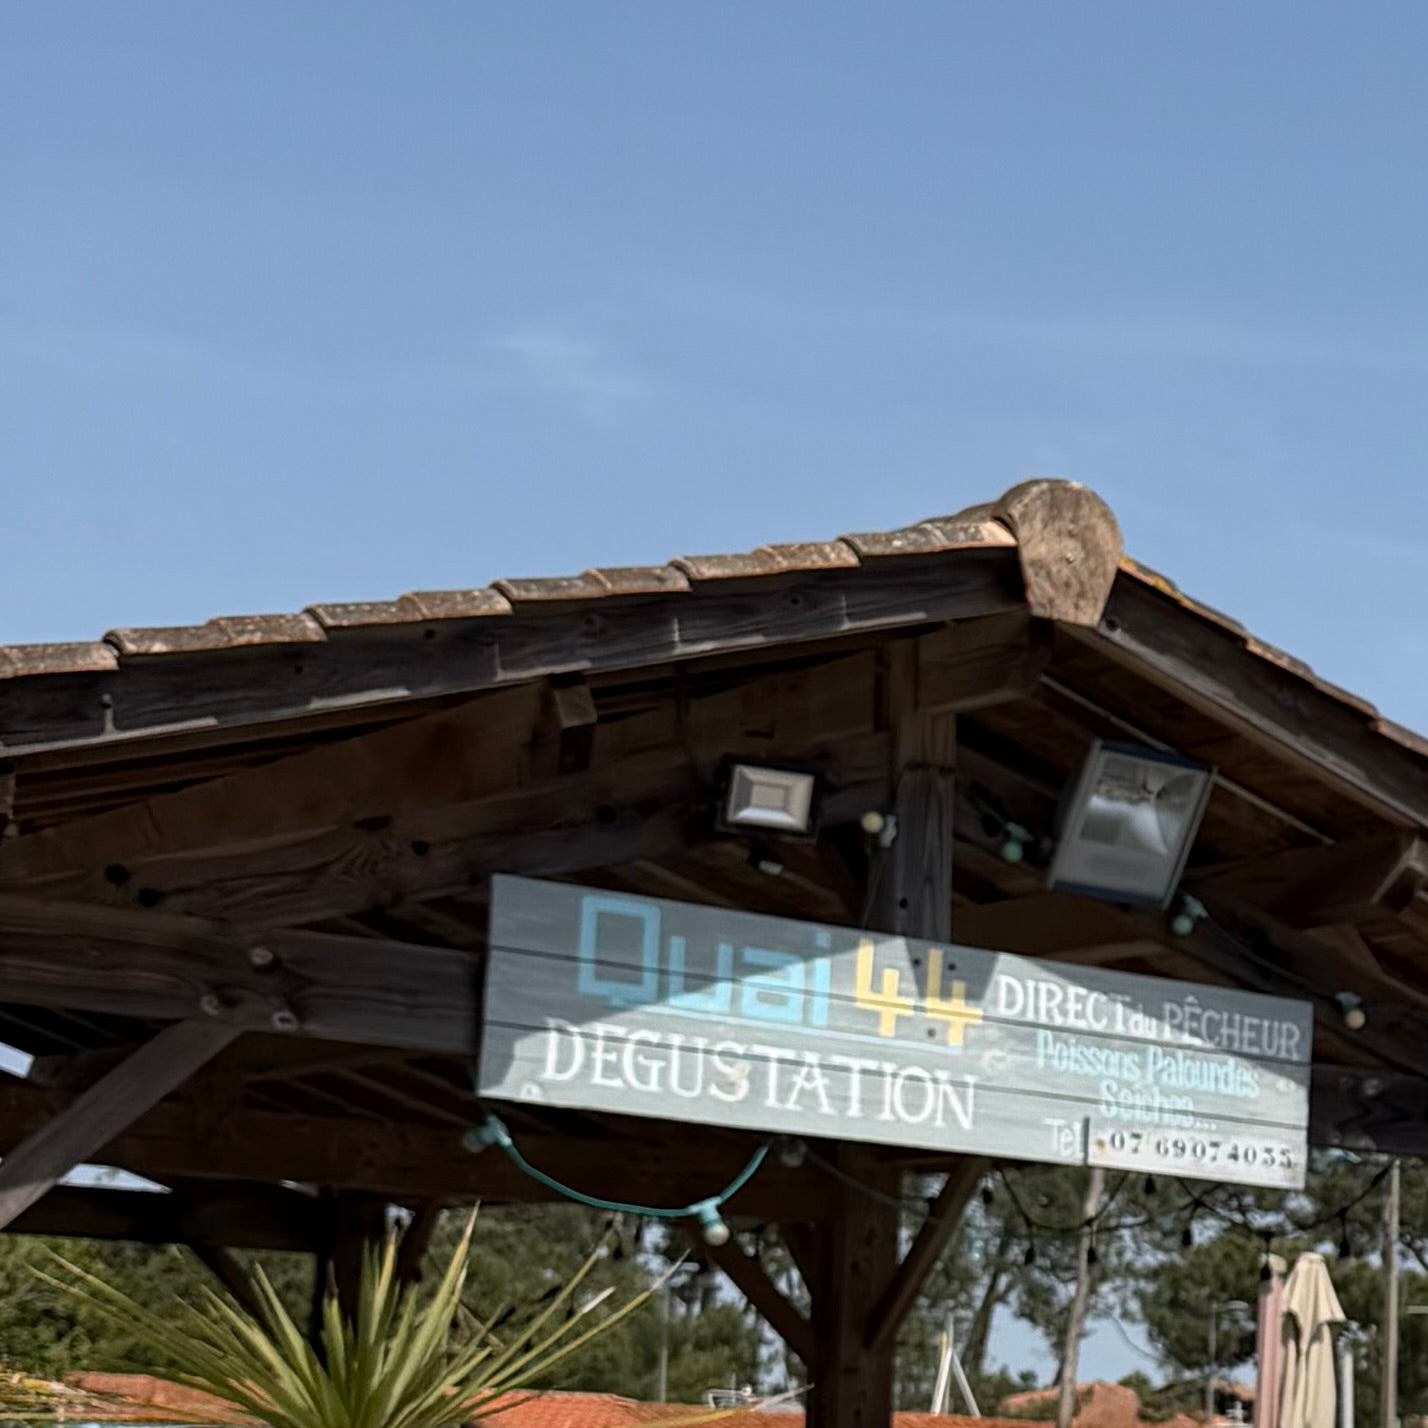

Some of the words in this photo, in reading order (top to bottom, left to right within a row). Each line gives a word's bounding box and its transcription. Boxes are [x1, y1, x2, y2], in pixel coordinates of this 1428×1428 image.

[579, 896, 831, 1027] Quai
[856, 938, 983, 1047] 44
[997, 974, 1132, 1032] DIRECT
[1162, 995, 1302, 1061] PÊCHEUR
[543, 1017, 977, 1130] DEGUSTATION
[1035, 1029, 1142, 1084] Poissons
[1144, 1045, 1260, 1099] Palourdes
[1110, 1130, 1144, 1154] 07
